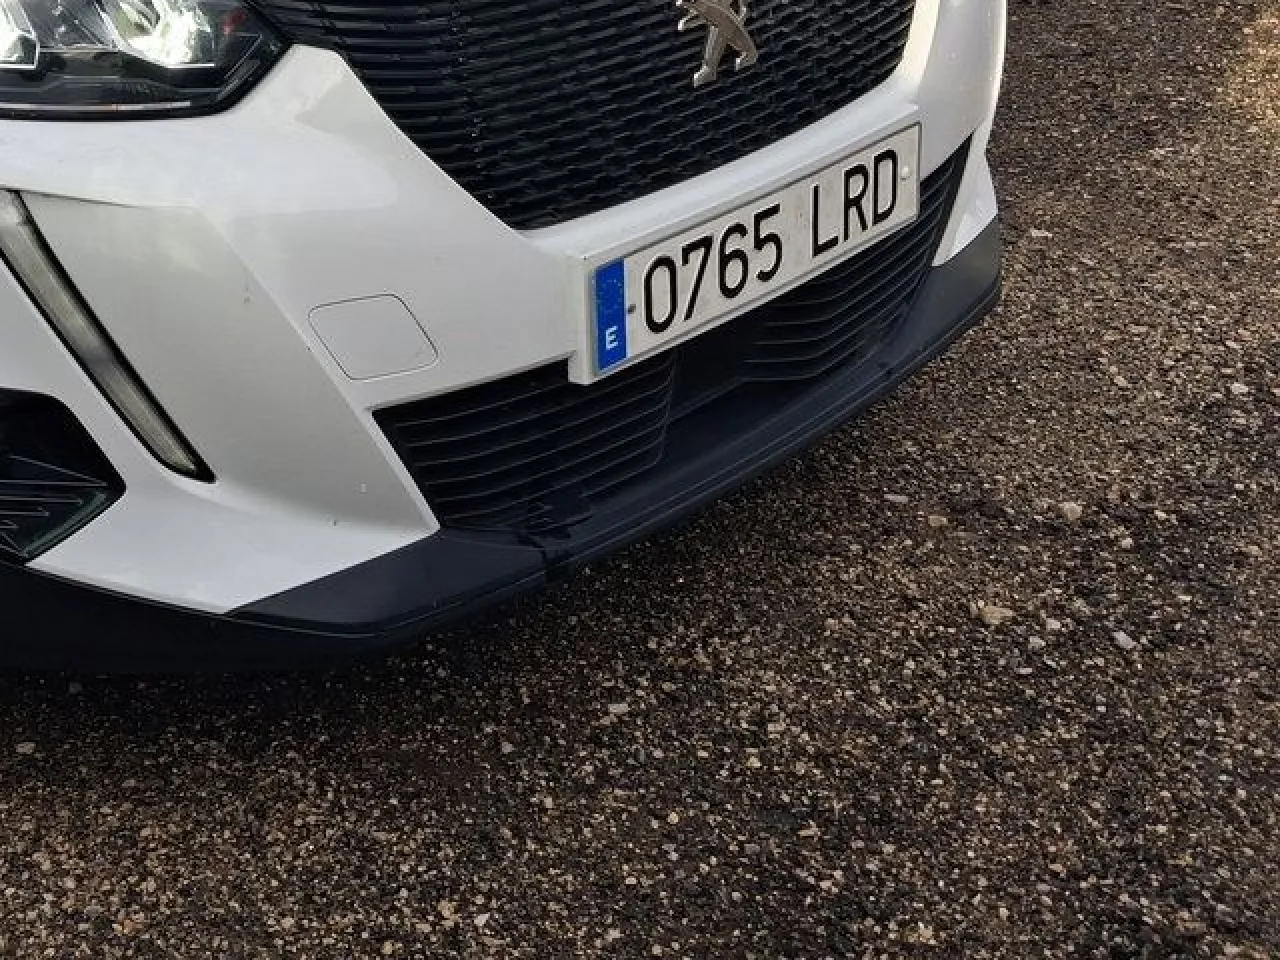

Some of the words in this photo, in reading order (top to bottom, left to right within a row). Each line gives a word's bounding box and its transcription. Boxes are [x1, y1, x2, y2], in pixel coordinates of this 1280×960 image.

[643, 204, 782, 334] 0765
[810, 149, 899, 257] LRD
[605, 325, 619, 350] E
